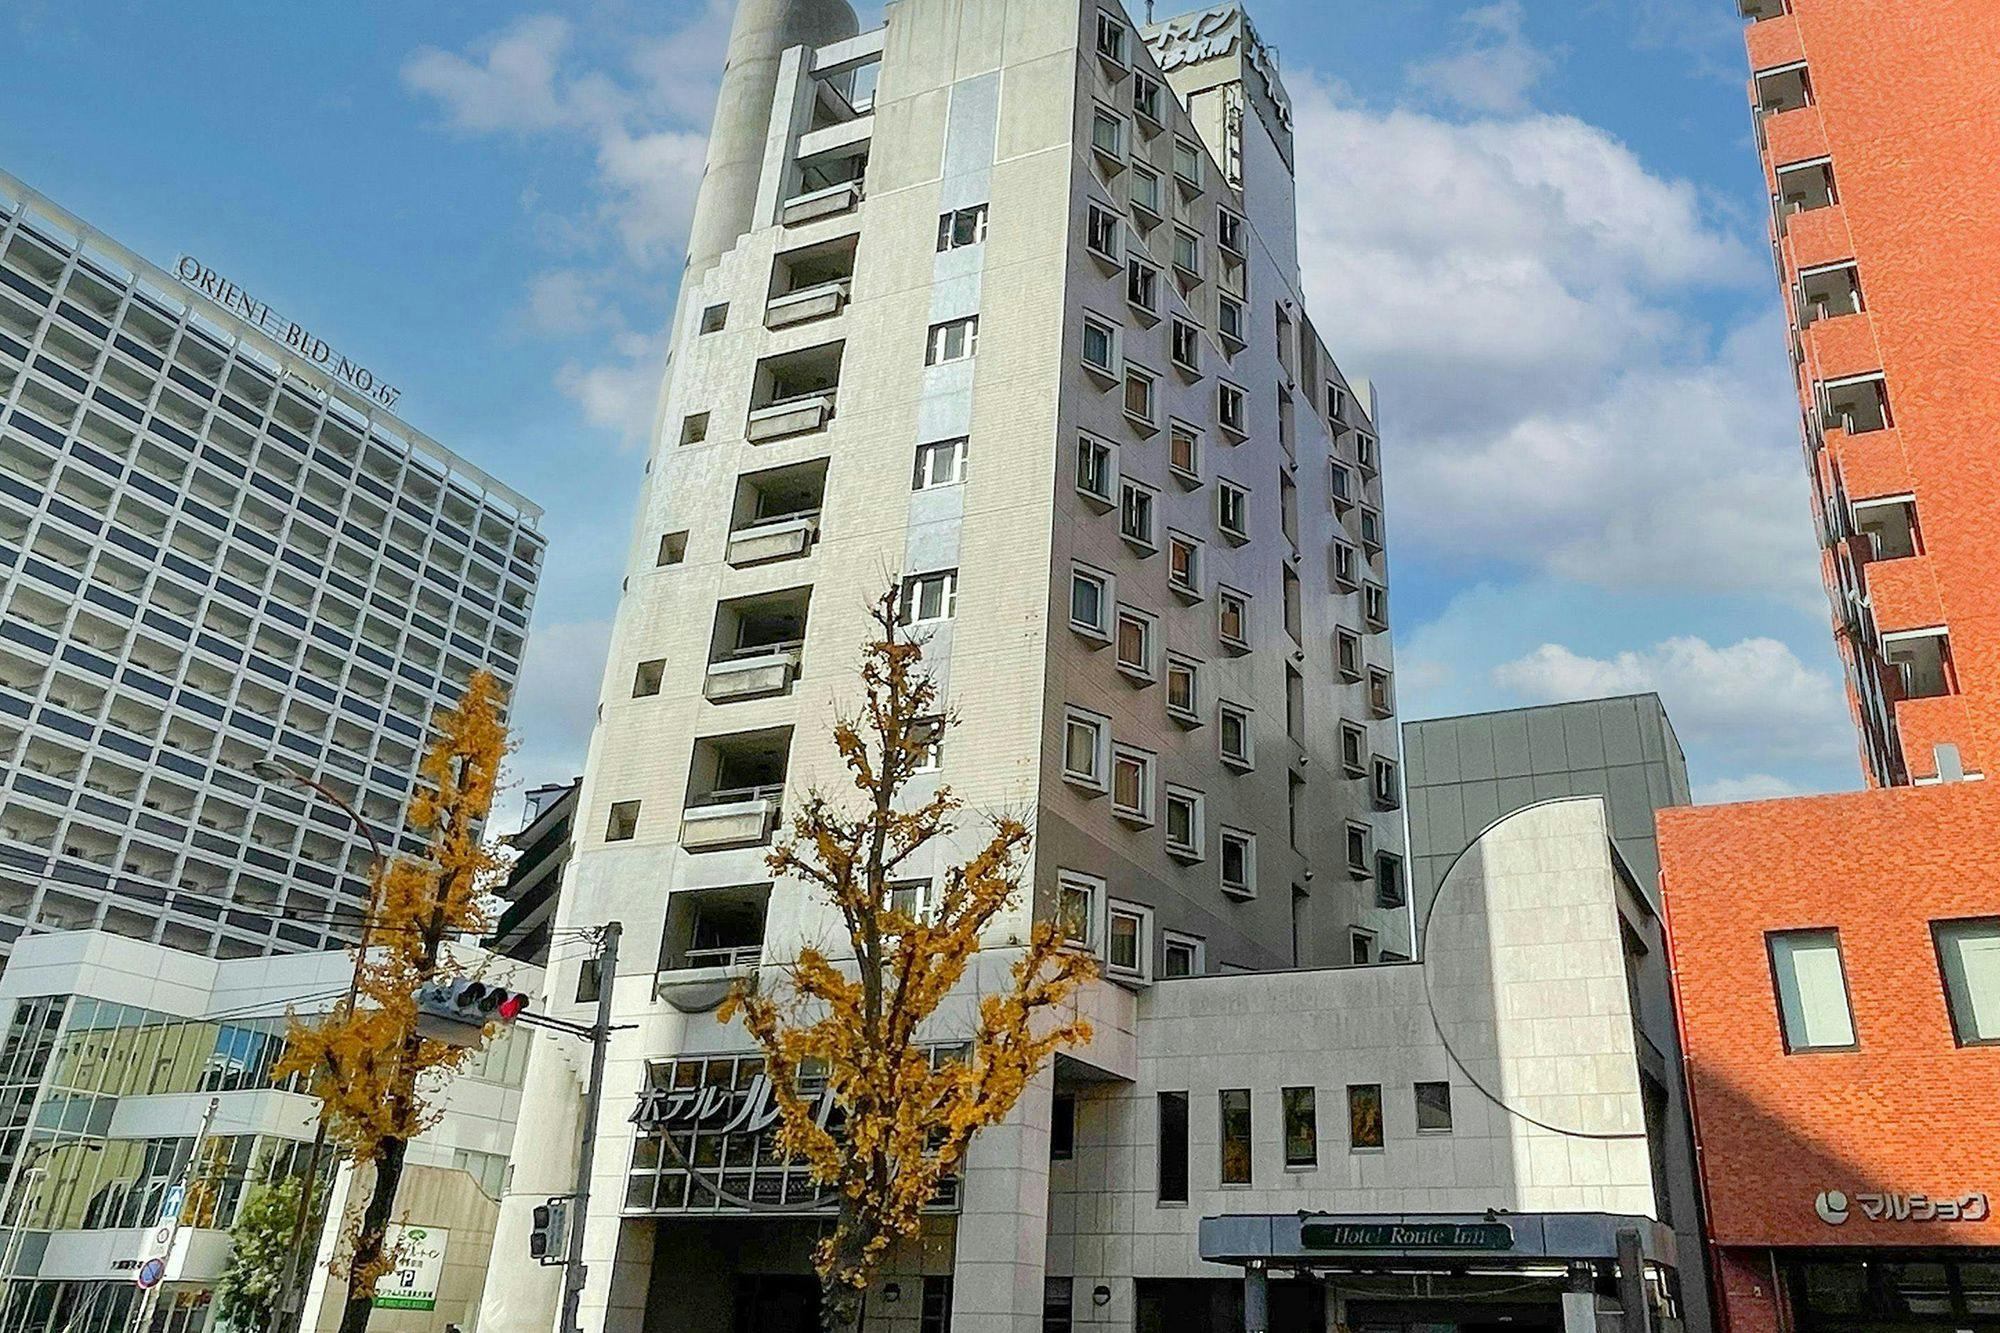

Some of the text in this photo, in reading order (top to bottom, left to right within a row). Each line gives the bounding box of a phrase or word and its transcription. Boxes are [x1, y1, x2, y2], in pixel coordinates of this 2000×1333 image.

[179, 256, 273, 325] ORIENT
[285, 322, 330, 364] BLD
[1856, 1193, 1989, 1221] マルショク
[1333, 1226, 1486, 1244] Hotel Route Inn
